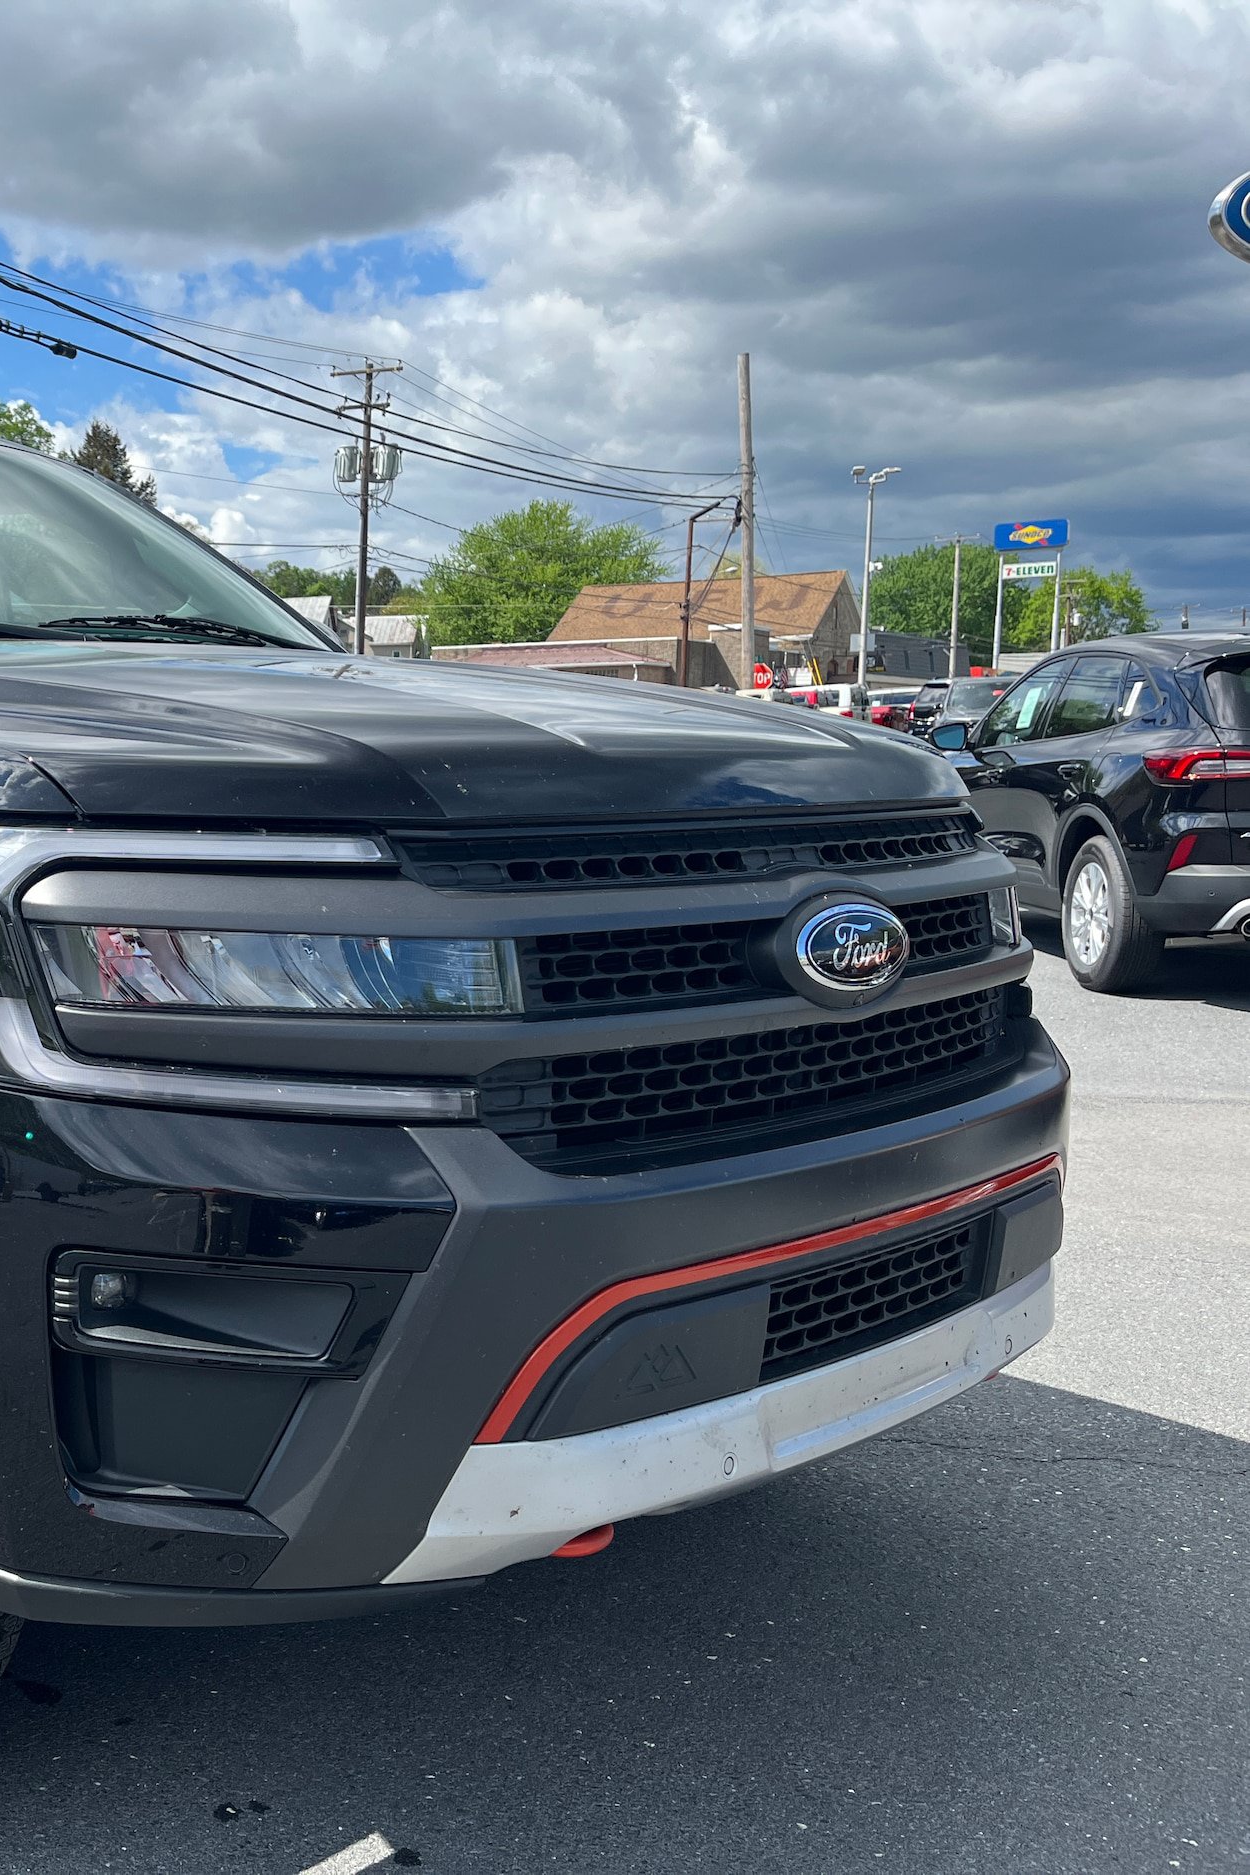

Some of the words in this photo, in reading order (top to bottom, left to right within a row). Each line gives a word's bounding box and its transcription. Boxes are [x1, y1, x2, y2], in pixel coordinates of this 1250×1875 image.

[1011, 529, 1051, 540] SUNOCO
[753, 672, 771, 684] TOP
[833, 922, 892, 971] Ford
